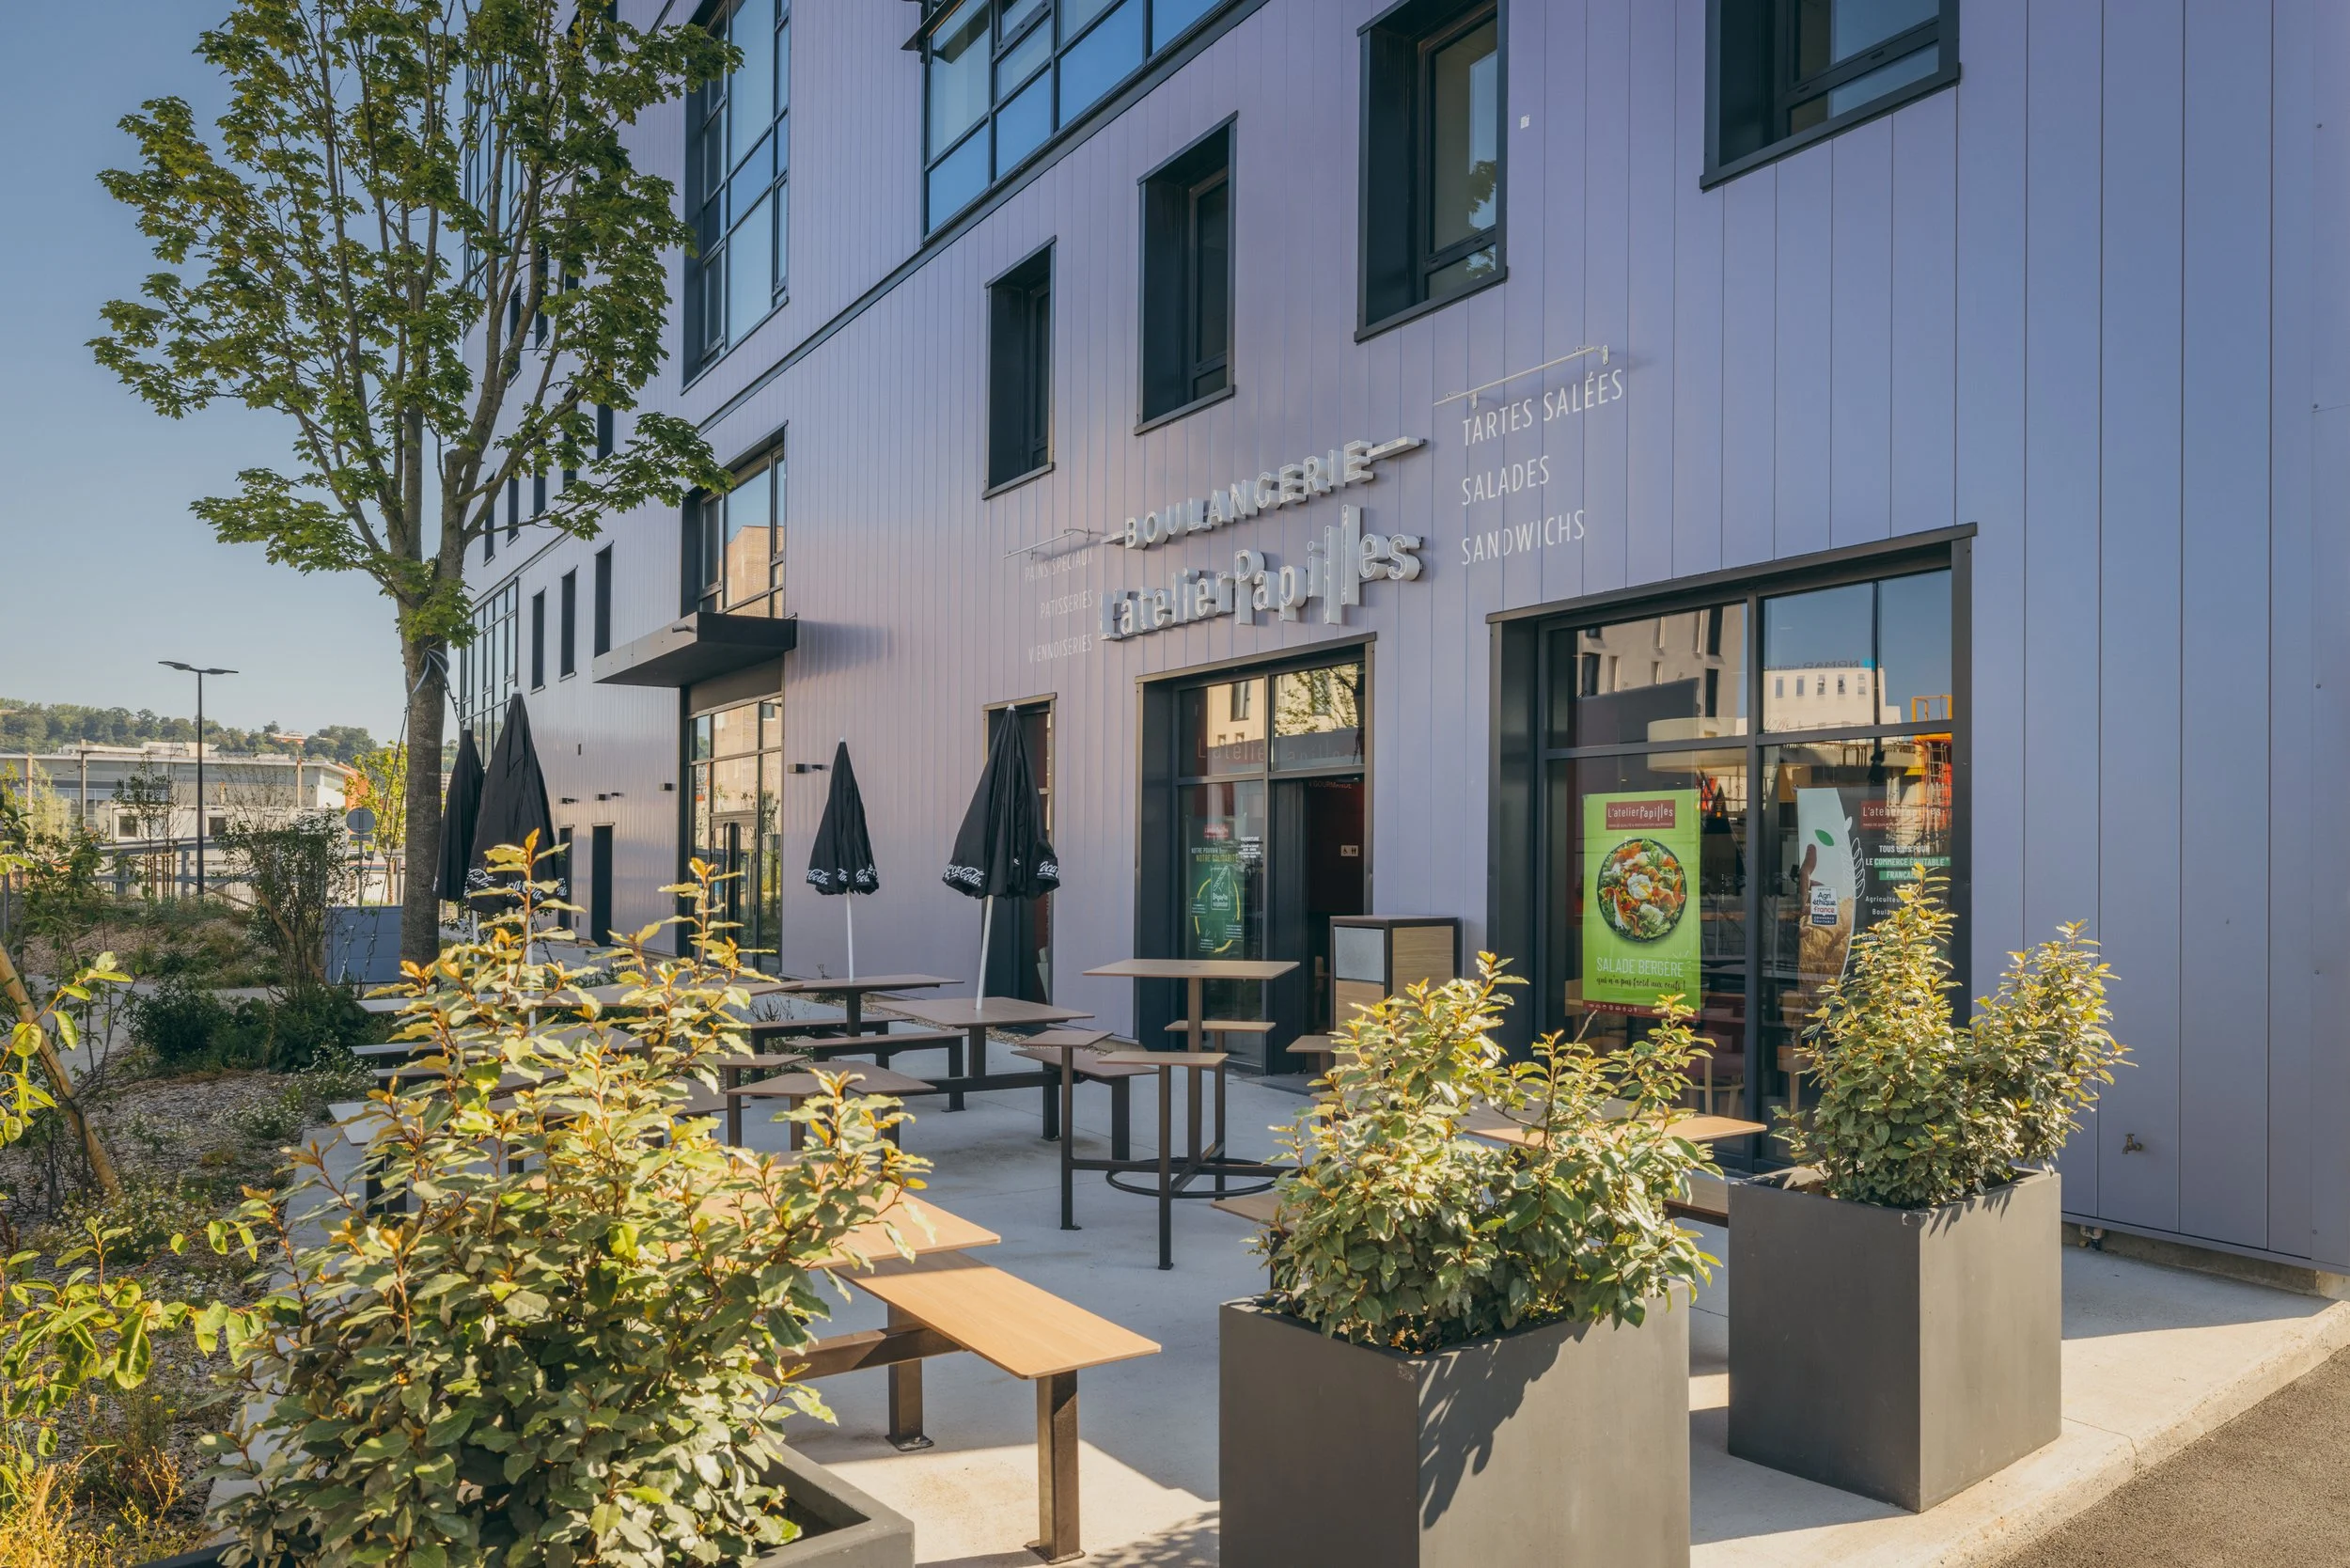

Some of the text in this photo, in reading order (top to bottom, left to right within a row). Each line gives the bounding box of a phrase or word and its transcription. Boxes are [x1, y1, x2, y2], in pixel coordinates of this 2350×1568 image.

[1463, 368, 1623, 447] TARTES SALÉES
[1462, 455, 1550, 506] SALADES
[1124, 439, 1373, 549] BOULANGERIE
[1461, 510, 1586, 565] SANDWICHS
[1025, 559, 1049, 584] PAINS
[1040, 589, 1093, 620] PATISSERIES
[1865, 857, 1873, 866] LE
[1873, 857, 1908, 866] COMMERCE
[1879, 845, 1895, 854] TOUS
[1817, 891, 1832, 901] Agri
[1596, 956, 1685, 979] SALADE BERGÈRE
[1620, 978, 1632, 988] pas
